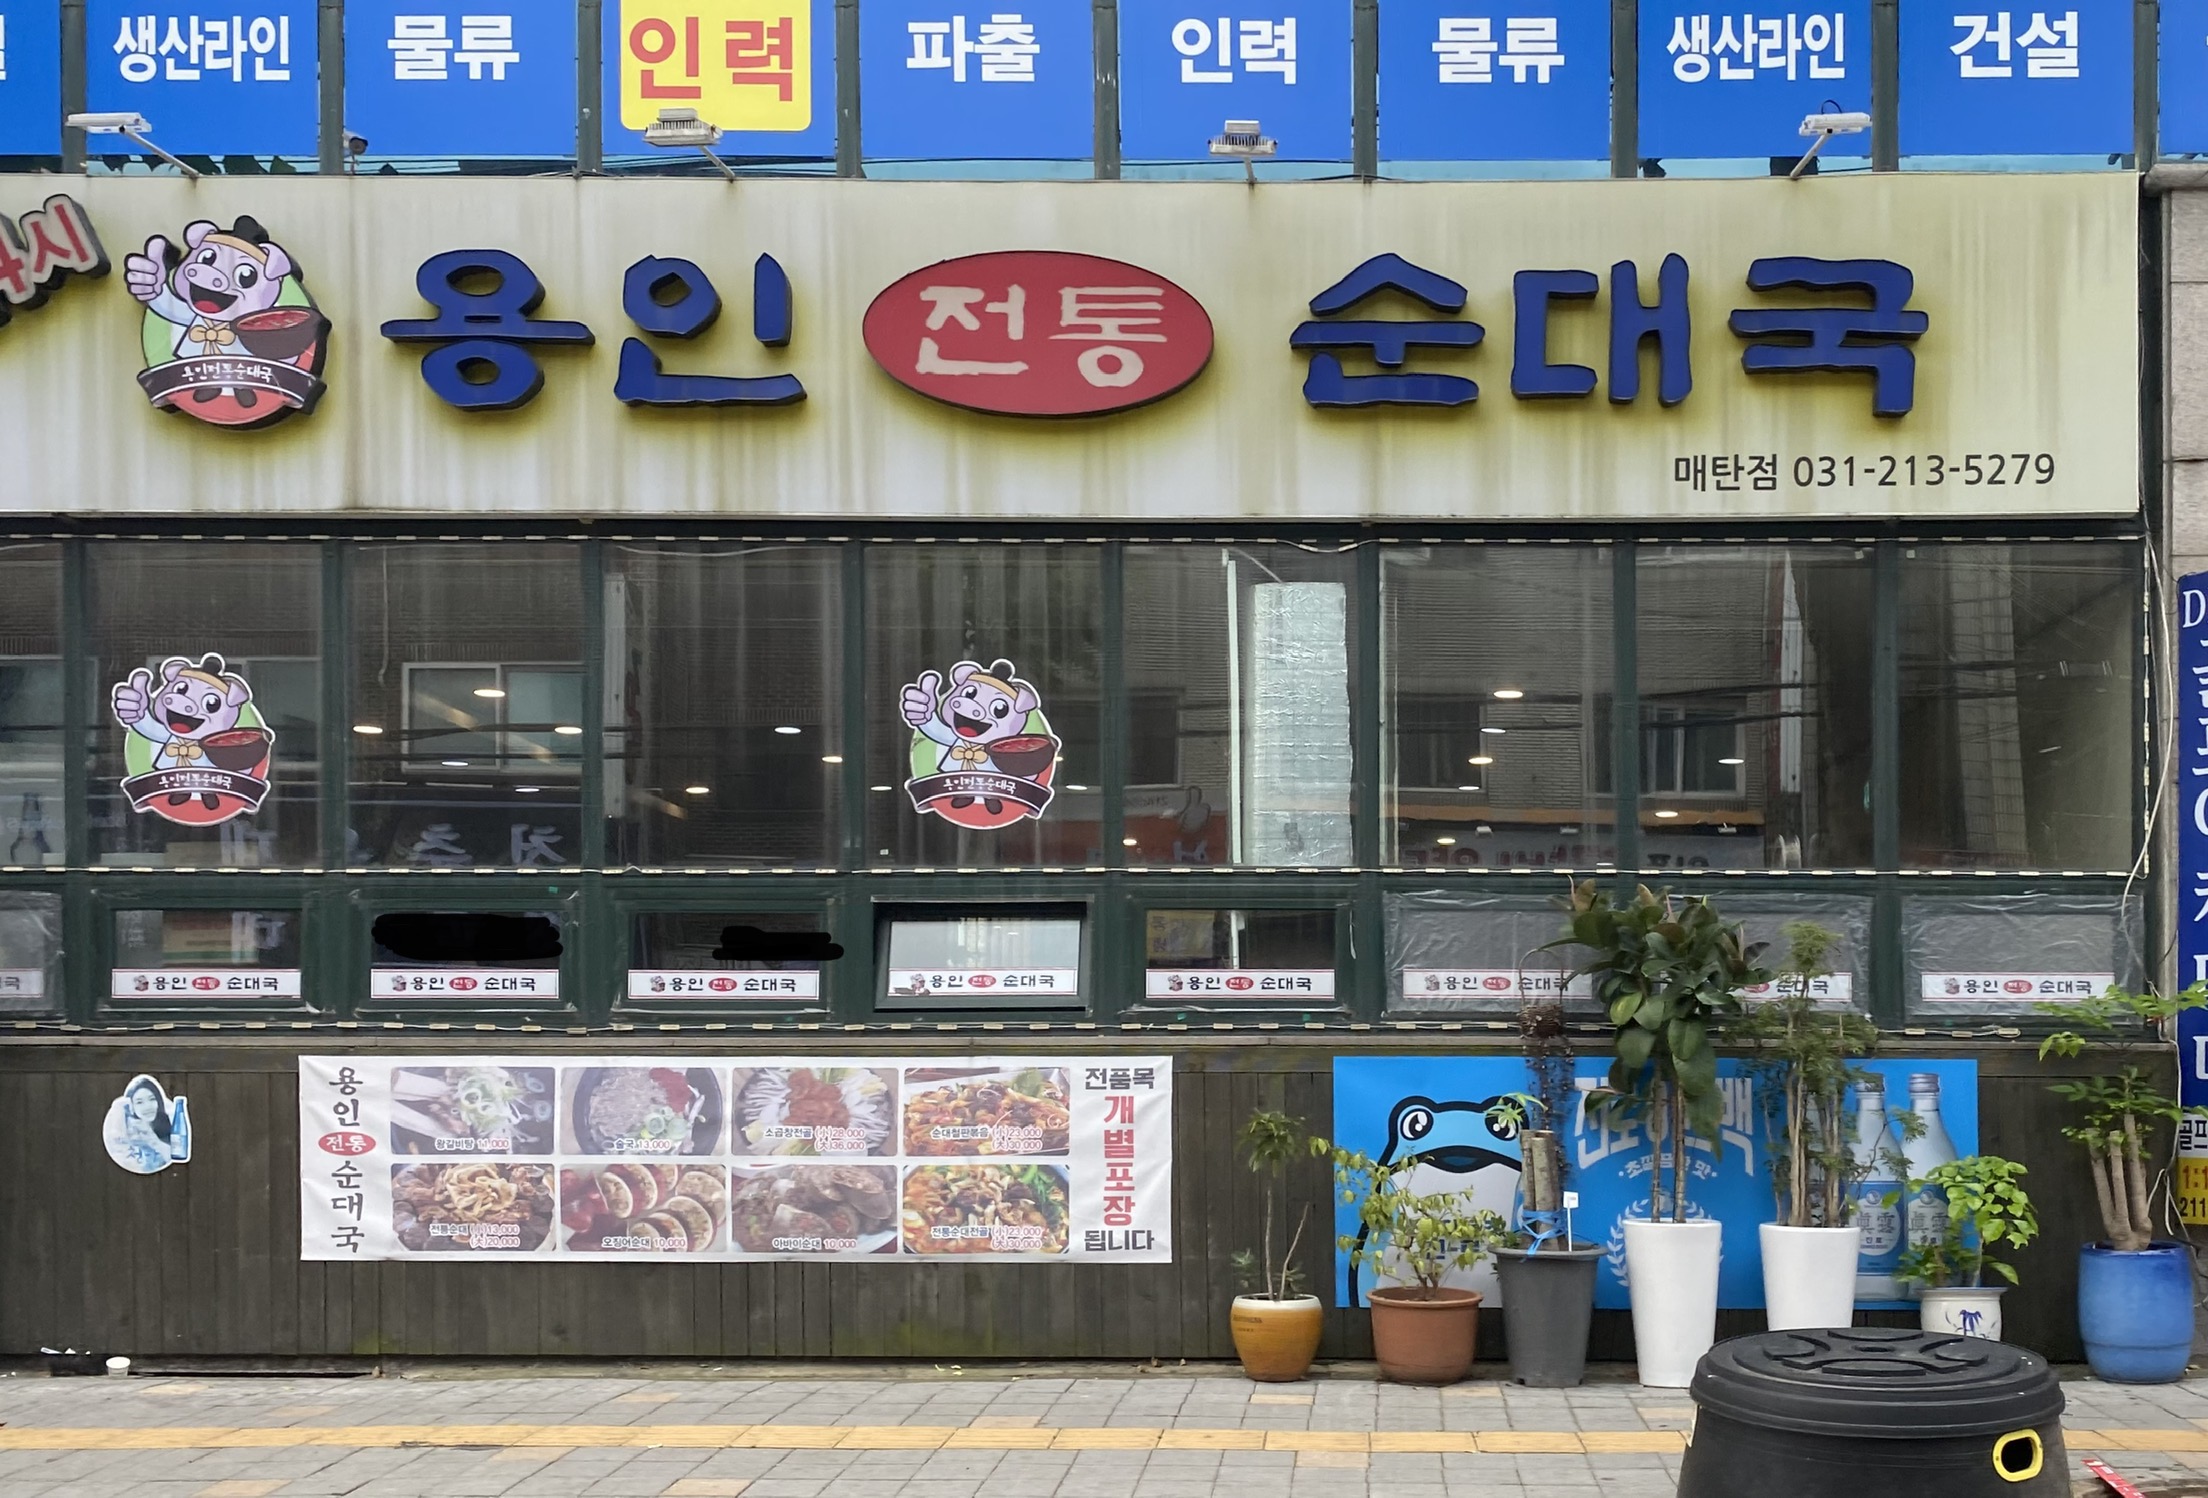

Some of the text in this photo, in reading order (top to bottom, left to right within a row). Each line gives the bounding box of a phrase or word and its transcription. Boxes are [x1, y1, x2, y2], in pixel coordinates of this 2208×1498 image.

[113, 15, 291, 83] 생산라인
[386, 15, 521, 82] 물류
[629, 16, 793, 102] 인력
[906, 13, 1041, 84] 파출
[1171, 16, 1297, 86] 인력
[1431, 17, 1566, 85] 물류
[1666, 13, 1846, 83] 생산라인
[1950, 11, 2081, 80] 건설
[380, 249, 1930, 419] 용인 전통 순대국
[1673, 453, 2056, 493] 매탄점 031-213-5279
[0, 976, 20, 990] 국
[152, 974, 187, 992] 용인
[226, 974, 279, 992] 순대국
[410, 974, 444, 992] 용인
[483, 974, 537, 992] 순대국
[669, 976, 704, 993] 용인
[744, 976, 797, 993] 순대국
[929, 974, 963, 989] 용인
[1002, 974, 1055, 989] 순대국
[1187, 975, 1221, 991] 용인
[1260, 975, 1313, 991] 순대국
[1443, 976, 1478, 991] 용인
[1963, 978, 1999, 995] 용인
[2038, 978, 2093, 995] 순대국
[1085, 1067, 1156, 1090] 전품목
[326, 1066, 367, 1254] 용인 전통 순대국
[1103, 1096, 1136, 1227] 개별포장
[773, 1239, 821, 1249] 아바이순대
[1084, 1230, 1156, 1252] 됩니다
